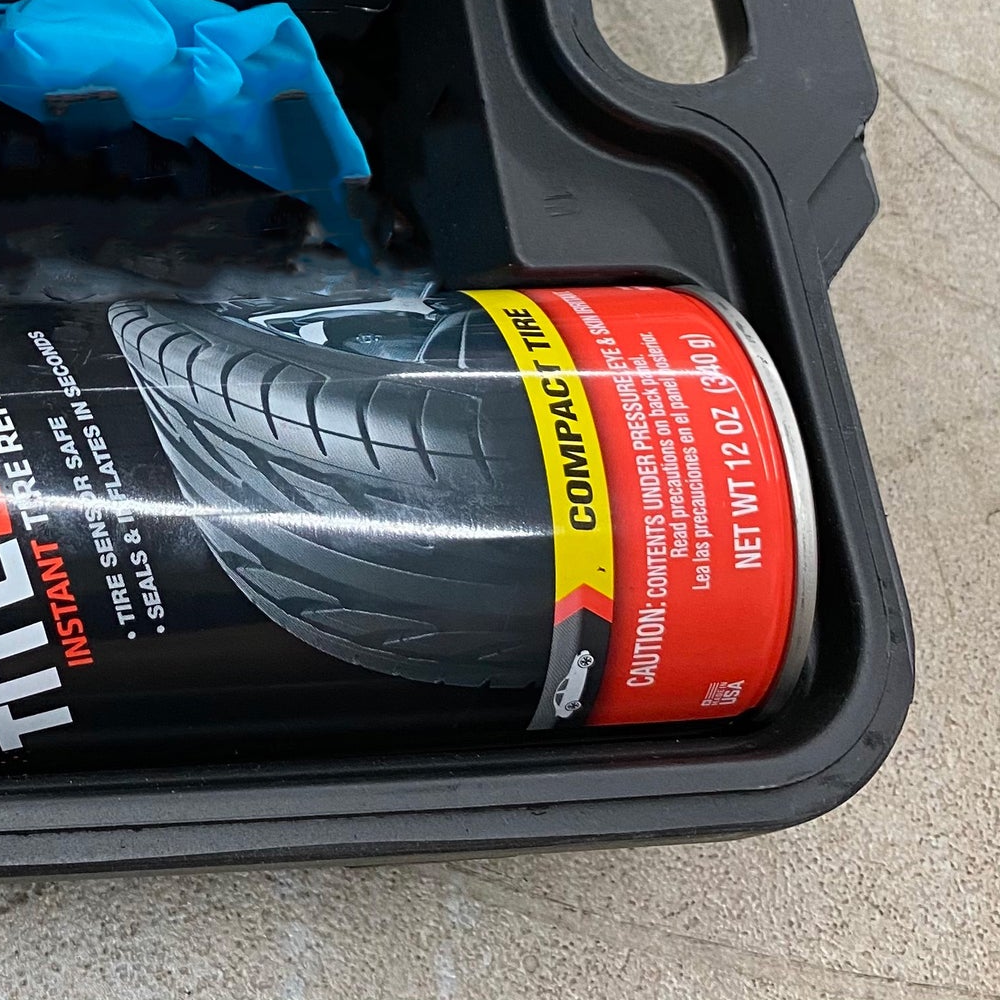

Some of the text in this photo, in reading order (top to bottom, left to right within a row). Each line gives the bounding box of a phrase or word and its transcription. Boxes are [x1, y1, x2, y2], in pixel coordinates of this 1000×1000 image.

[579, 314, 611, 335] SKIN
[595, 337, 616, 346] &
[28, 330, 81, 398] SECONDS
[600, 347, 629, 371] EYE
[641, 388, 667, 417] back
[658, 377, 690, 410] panel
[70, 401, 93, 421] IN
[503, 308, 597, 531] COMPACT TIRE
[654, 420, 672, 436] on
[669, 412, 690, 425] el
[48, 416, 83, 470] SAFE
[678, 427, 695, 444] en
[679, 333, 762, 569] NET WT 12 OZ (340 g)
[636, 454, 664, 511] UNDER
[659, 438, 691, 519] precautions
[683, 446, 714, 538] precauciones
[123, 528, 141, 544] &
[669, 522, 689, 558] Read
[692, 541, 711, 562] las
[644, 514, 668, 599] CONTENTS
[131, 550, 164, 620] SEALS
[692, 565, 712, 590] Lea
[30, 540, 94, 667] INSTANT
[106, 573, 135, 625] TIRE
[626, 602, 668, 687] CAUTION:
[719, 679, 745, 705] USA
